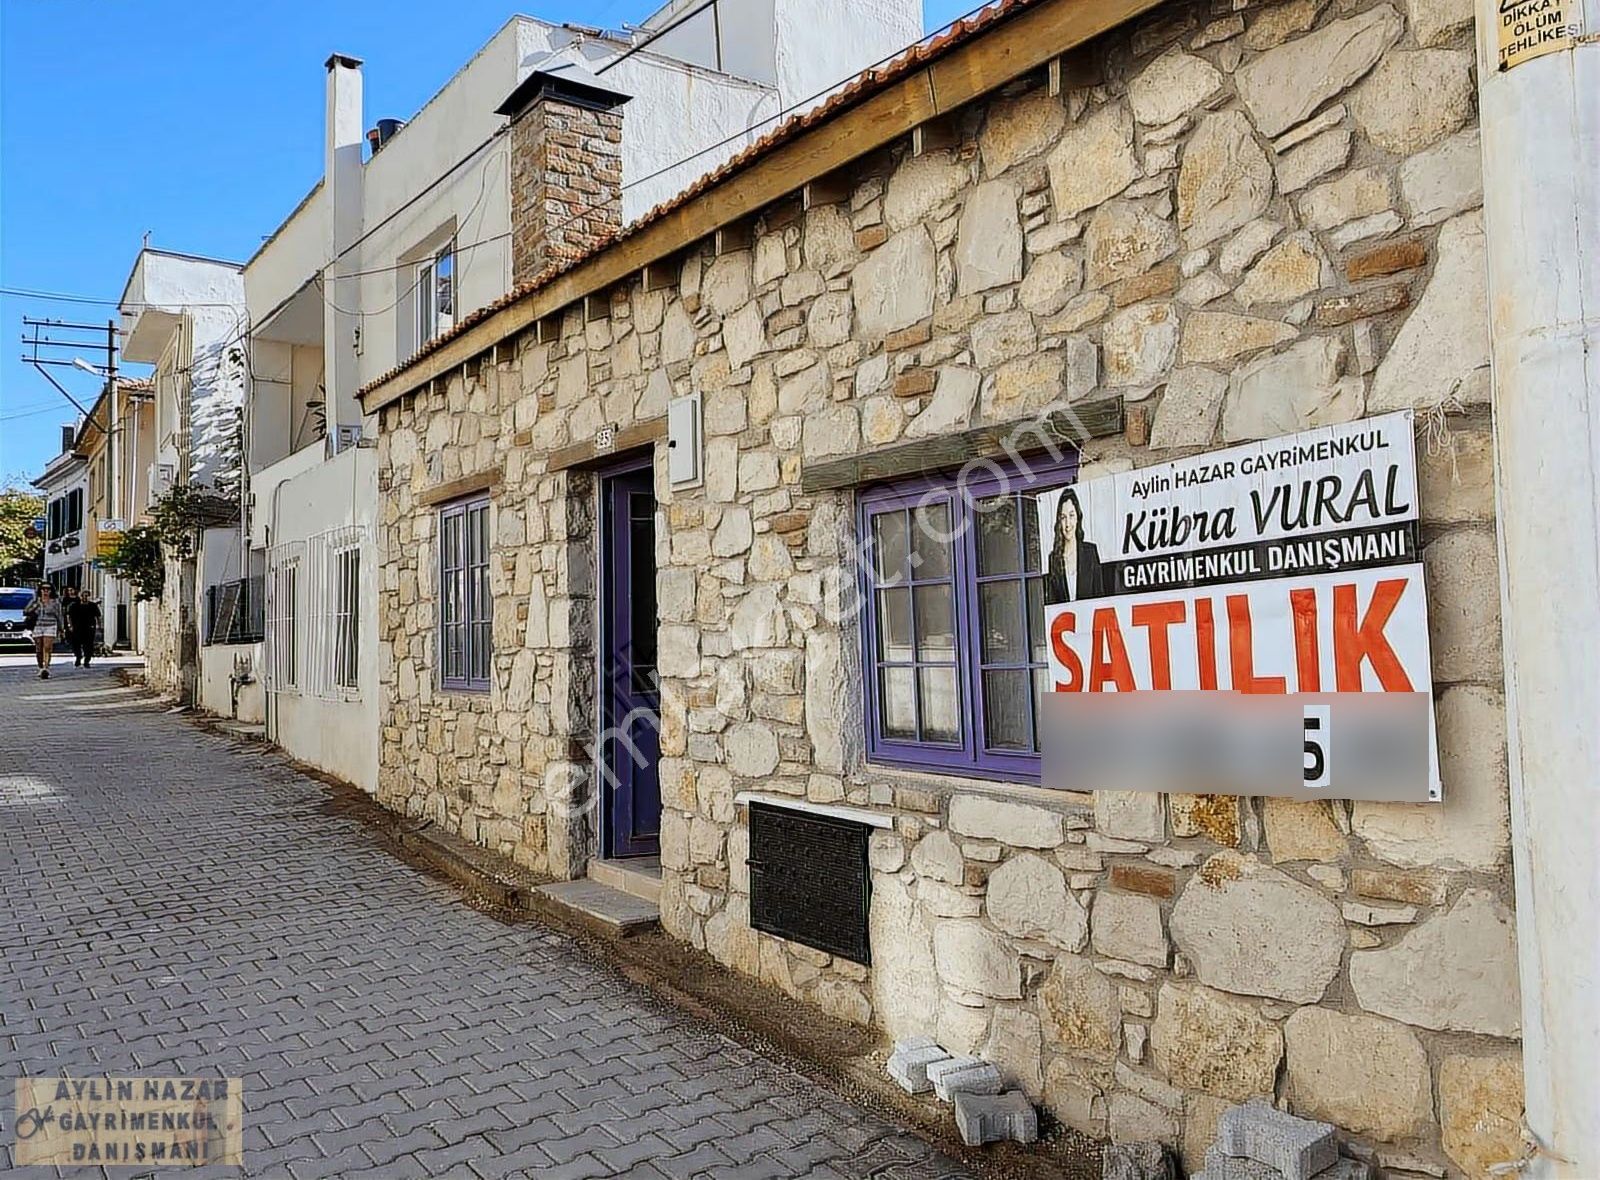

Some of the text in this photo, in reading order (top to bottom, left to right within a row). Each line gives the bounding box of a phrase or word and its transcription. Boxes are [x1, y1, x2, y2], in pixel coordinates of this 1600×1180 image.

[1513, 10, 1561, 36] ÖLÜM
[1131, 475, 1170, 498] Aylin
[1175, 461, 1236, 489] HAZAR
[1121, 464, 1410, 555] Kübra VURAL
[1123, 529, 1406, 588] GAYRİMENKUL DANIŞMANI
[1050, 578, 1416, 694] SATILIK
